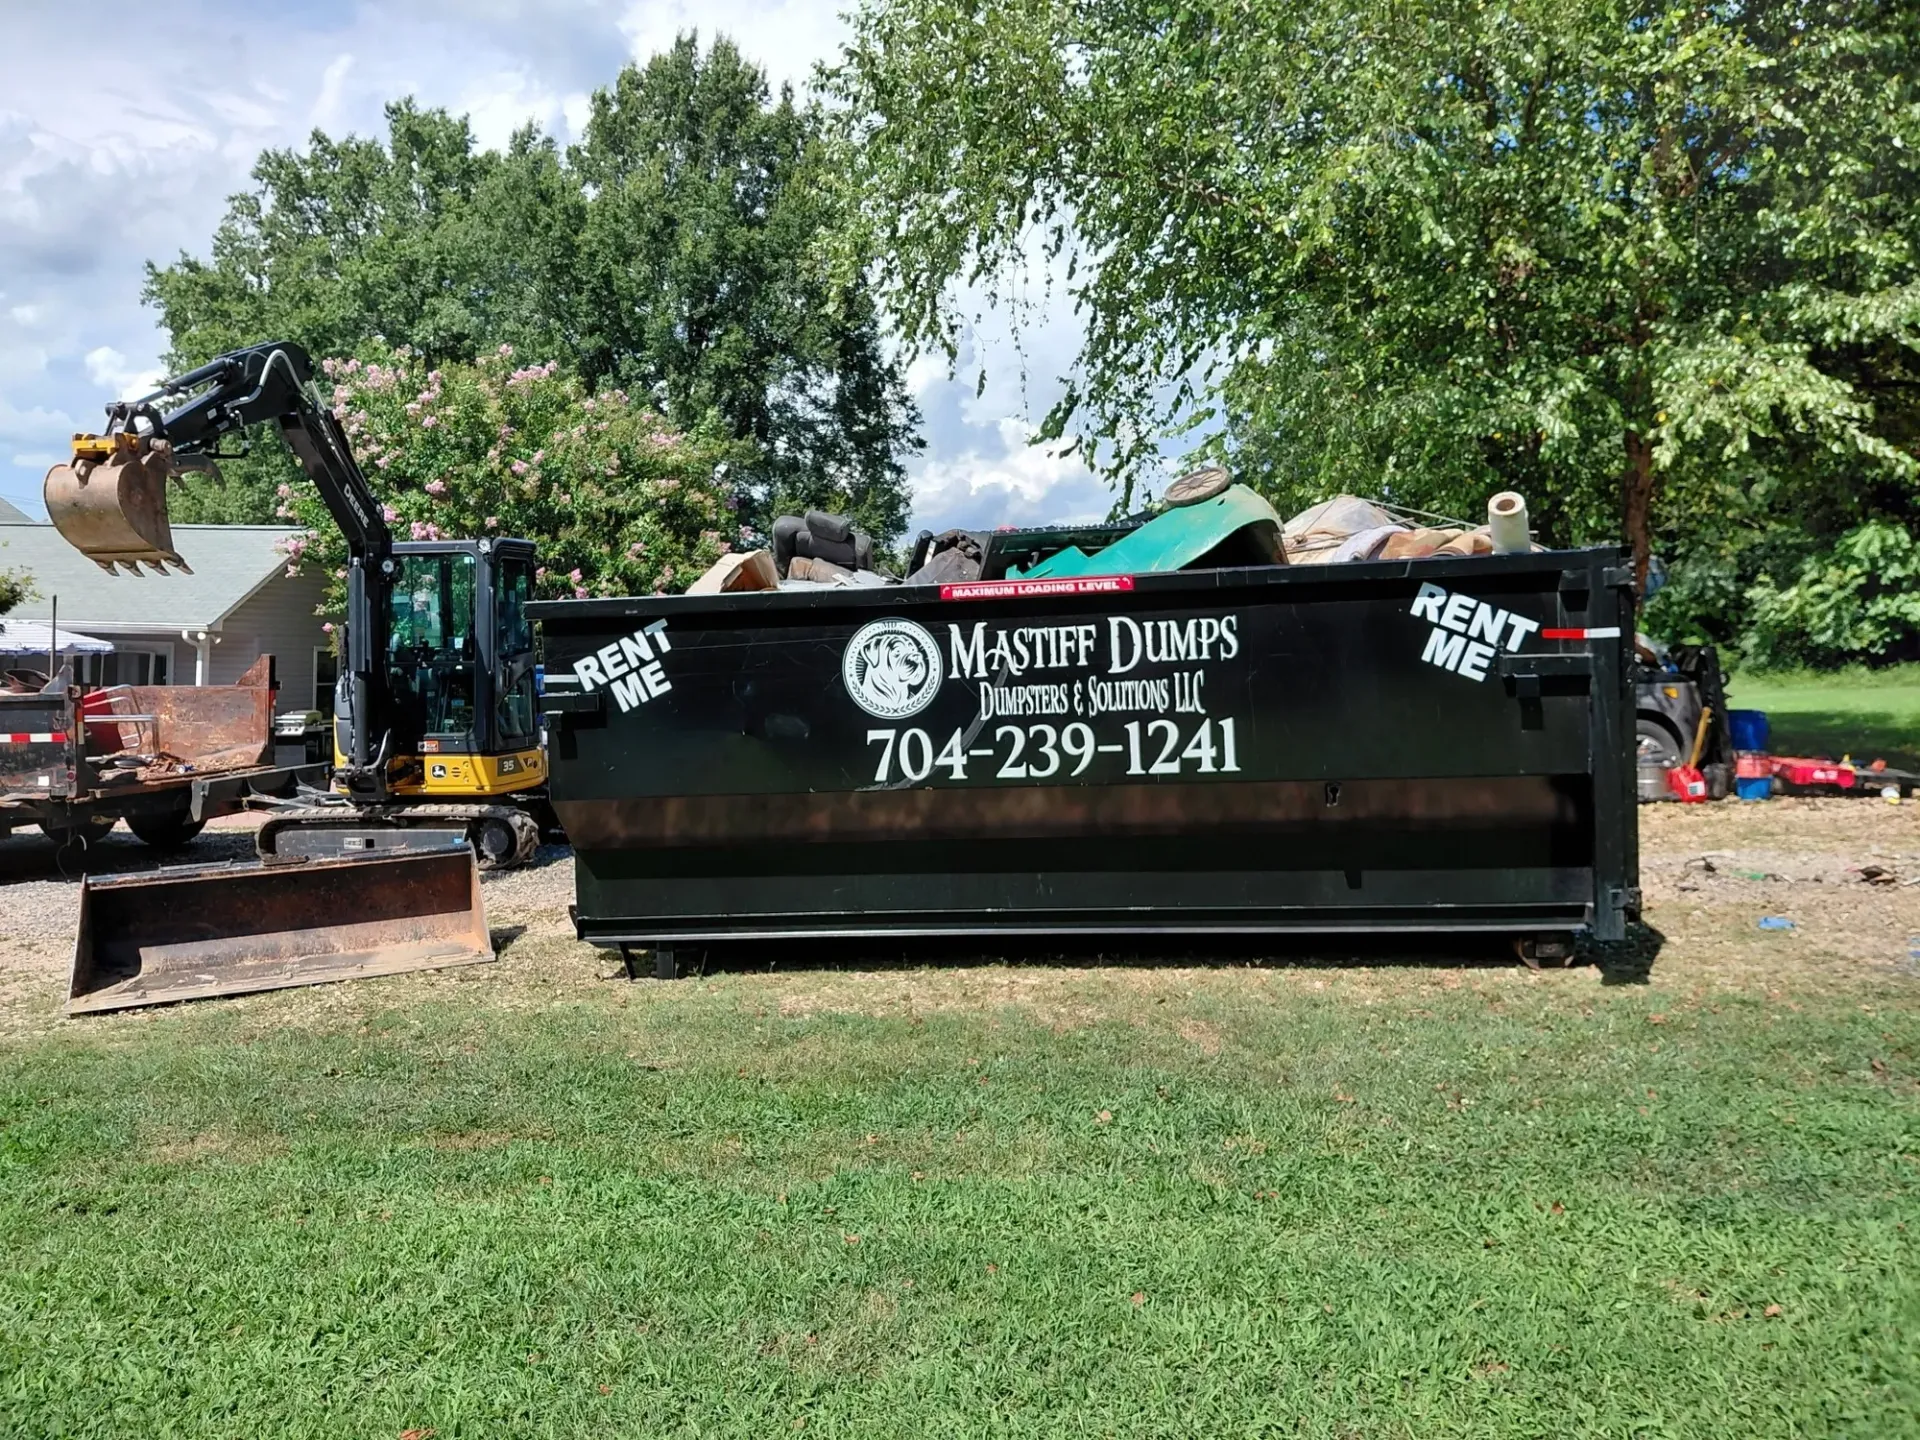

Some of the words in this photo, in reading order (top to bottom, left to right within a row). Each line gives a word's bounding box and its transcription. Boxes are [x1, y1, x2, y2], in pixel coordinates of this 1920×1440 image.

[344, 483, 369, 528] DEERE
[951, 587, 1015, 598] MAXIMUM
[1018, 583, 1075, 595] LOADING
[1078, 581, 1120, 592] LEVEL
[1409, 581, 1540, 653] RENT
[572, 618, 672, 692] RENT
[948, 621, 1097, 679] MASTIFF
[1107, 616, 1239, 674] DUMPS
[1420, 627, 1497, 683] ME
[610, 660, 672, 713] ME
[979, 681, 1069, 721] DUMPSTERS
[1074, 680, 1084, 716] &
[1088, 675, 1169, 718] SOLUTIONS
[1173, 669, 1206, 714] LLC
[503, 760, 514, 772] 35
[866, 717, 1242, 782] 704-239-1241
